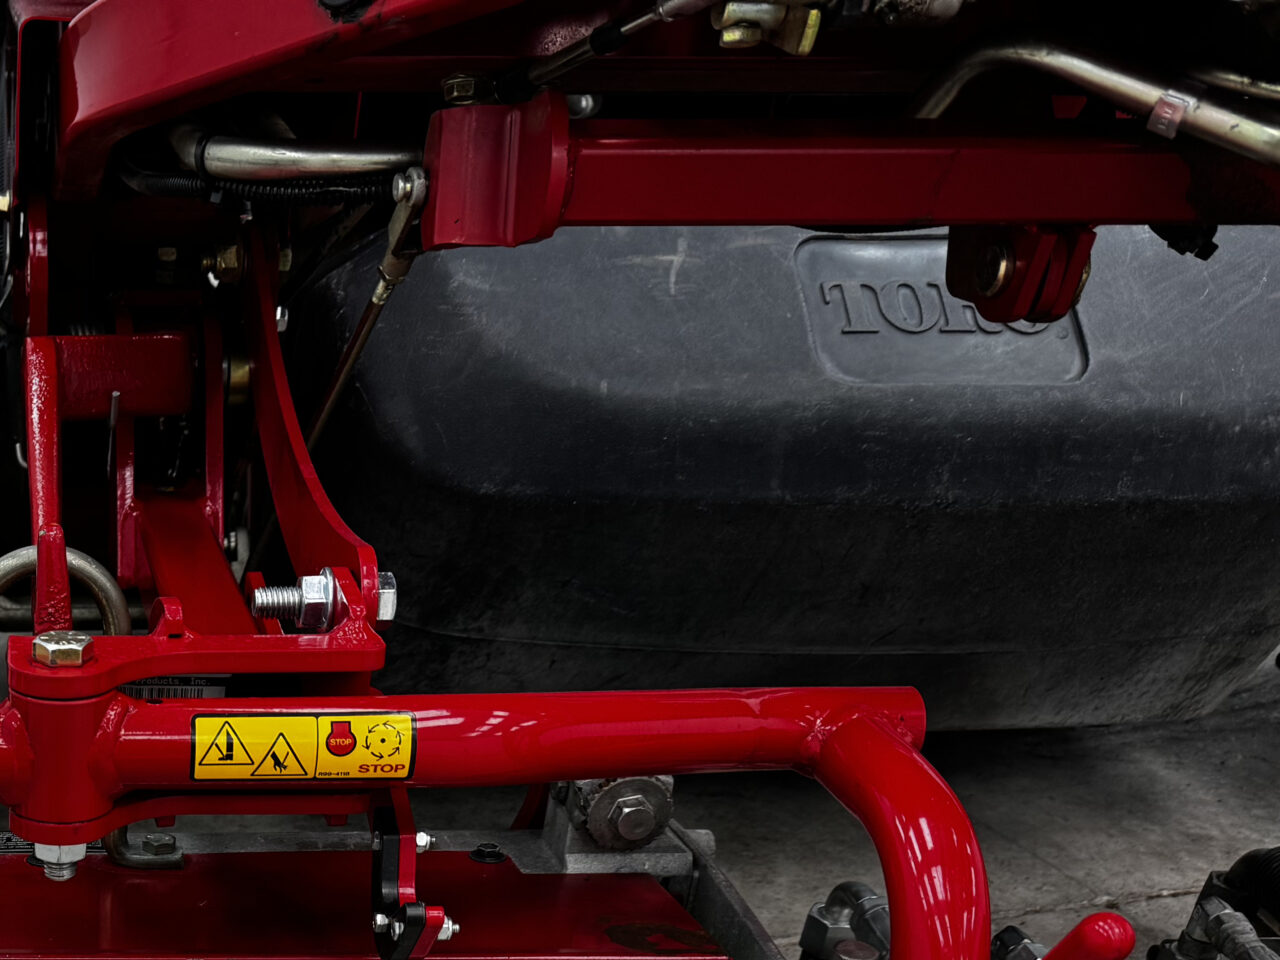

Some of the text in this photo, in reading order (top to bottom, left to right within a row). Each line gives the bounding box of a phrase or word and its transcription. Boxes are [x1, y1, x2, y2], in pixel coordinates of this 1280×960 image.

[820, 282, 1050, 336] TOR
[328, 737, 352, 746] STOP
[357, 763, 406, 774] STOP
